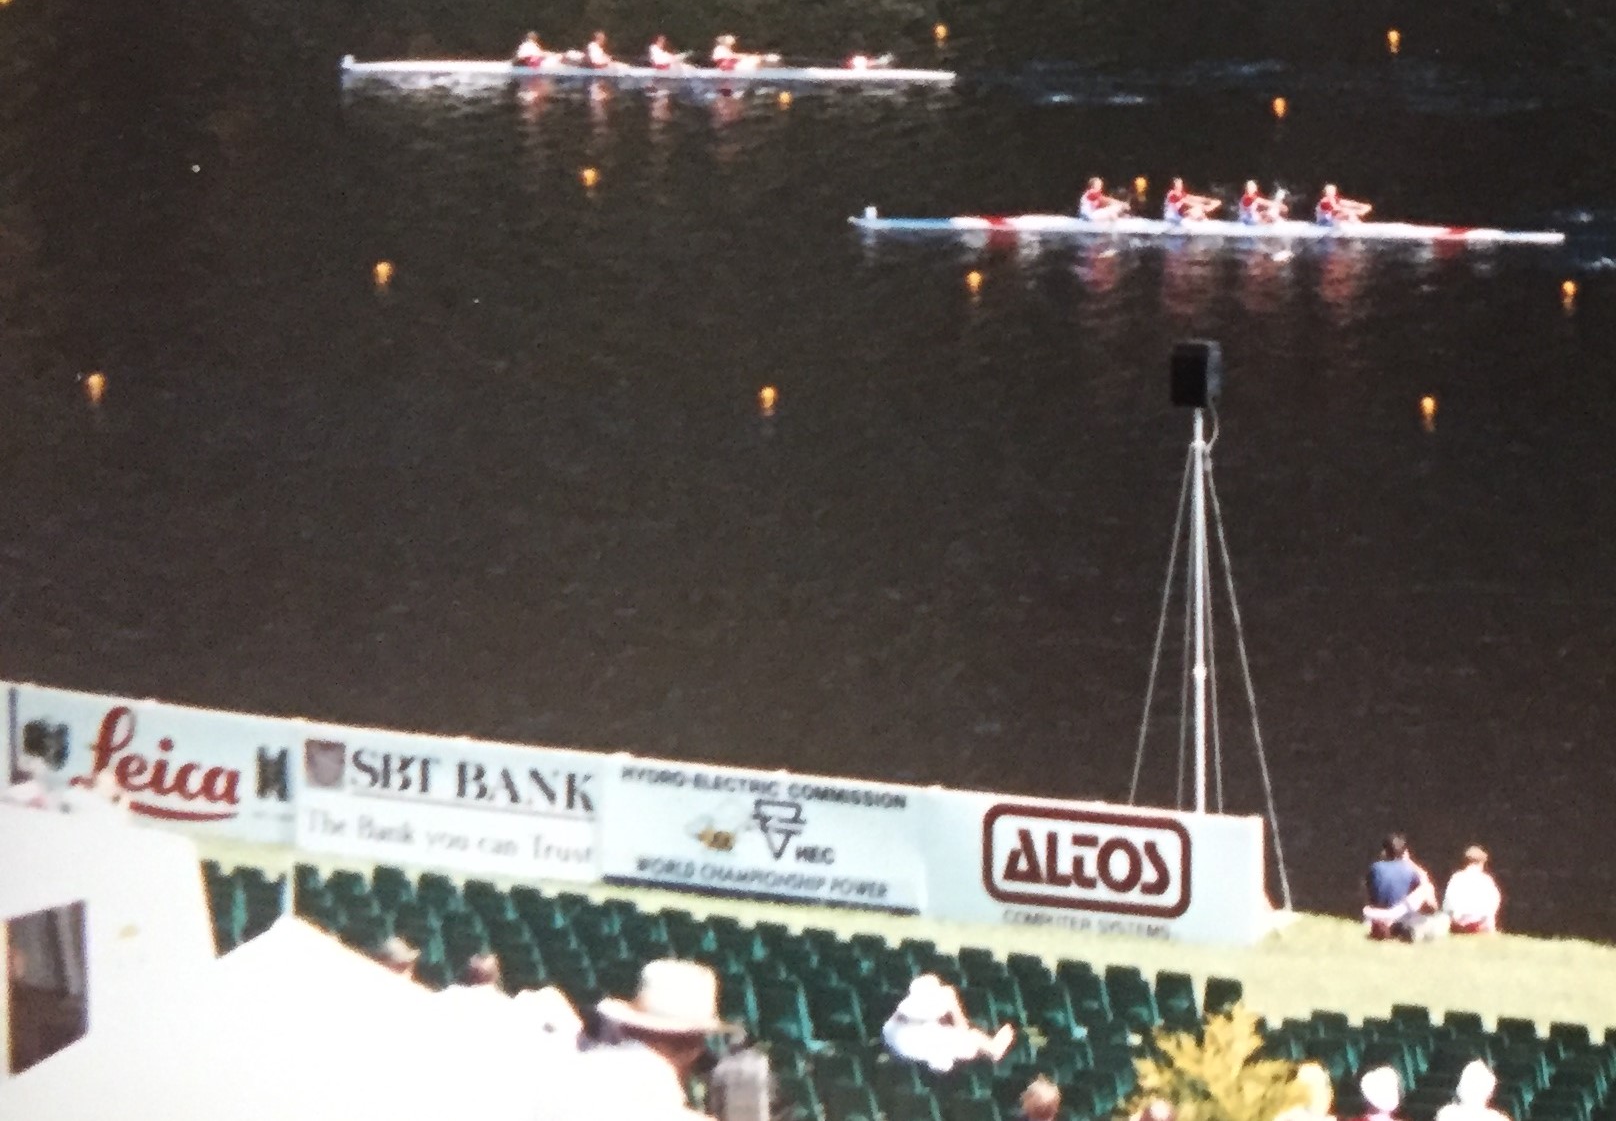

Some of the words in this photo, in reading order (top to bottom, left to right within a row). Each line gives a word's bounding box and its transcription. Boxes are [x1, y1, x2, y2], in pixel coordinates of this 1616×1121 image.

[69, 705, 242, 806] Leica
[351, 749, 440, 792] SBT
[456, 760, 594, 814] BANK
[307, 807, 347, 835] The
[357, 814, 415, 845] Bank
[427, 829, 471, 855] you
[477, 834, 519, 857] can
[1002, 828, 1171, 896] ALTOS
[1001, 908, 1092, 932] COMPUTER
